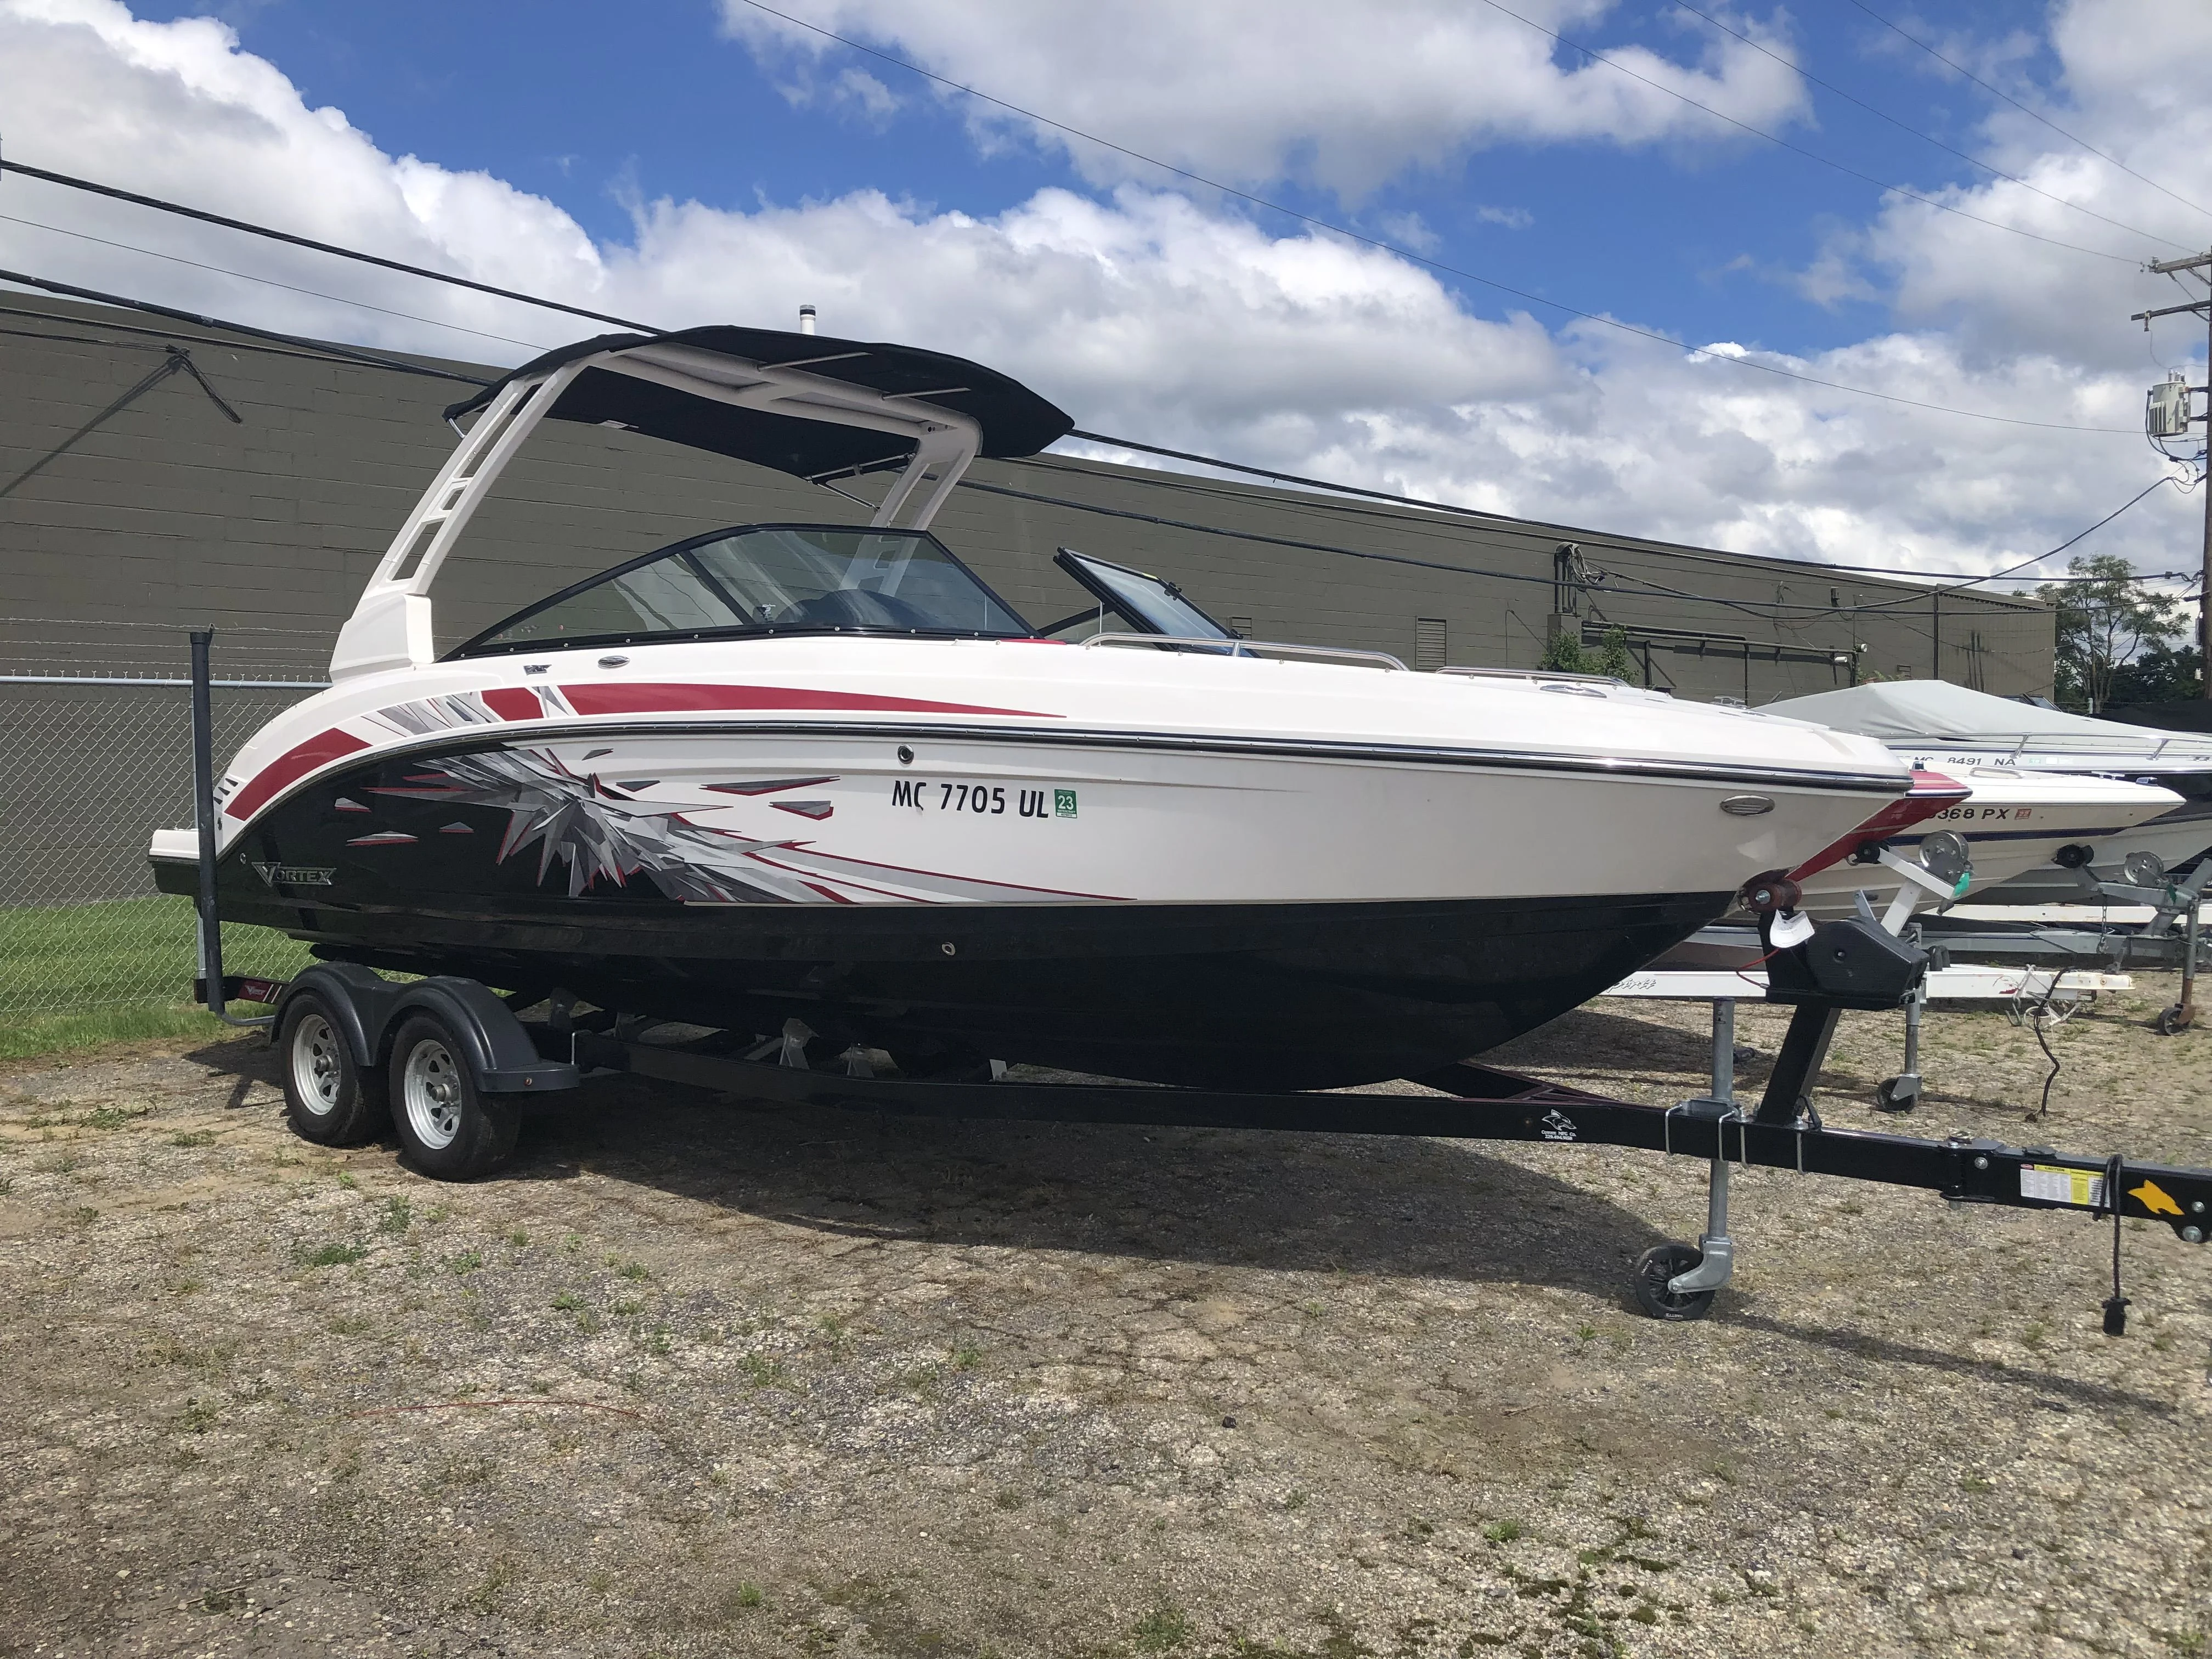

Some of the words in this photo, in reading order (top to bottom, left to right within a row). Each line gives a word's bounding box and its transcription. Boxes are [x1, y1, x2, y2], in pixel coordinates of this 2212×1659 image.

[1947, 757, 1982, 765] 8491
[891, 780, 927, 810] MC
[940, 783, 1005, 814] 7705
[1019, 789, 1049, 819] UL
[1058, 795, 1074, 810] 23
[1928, 808, 1975, 820] 368
[1981, 809, 2010, 820] PX
[251, 861, 337, 888] VORTEX
[1606, 978, 1657, 993] pirit
